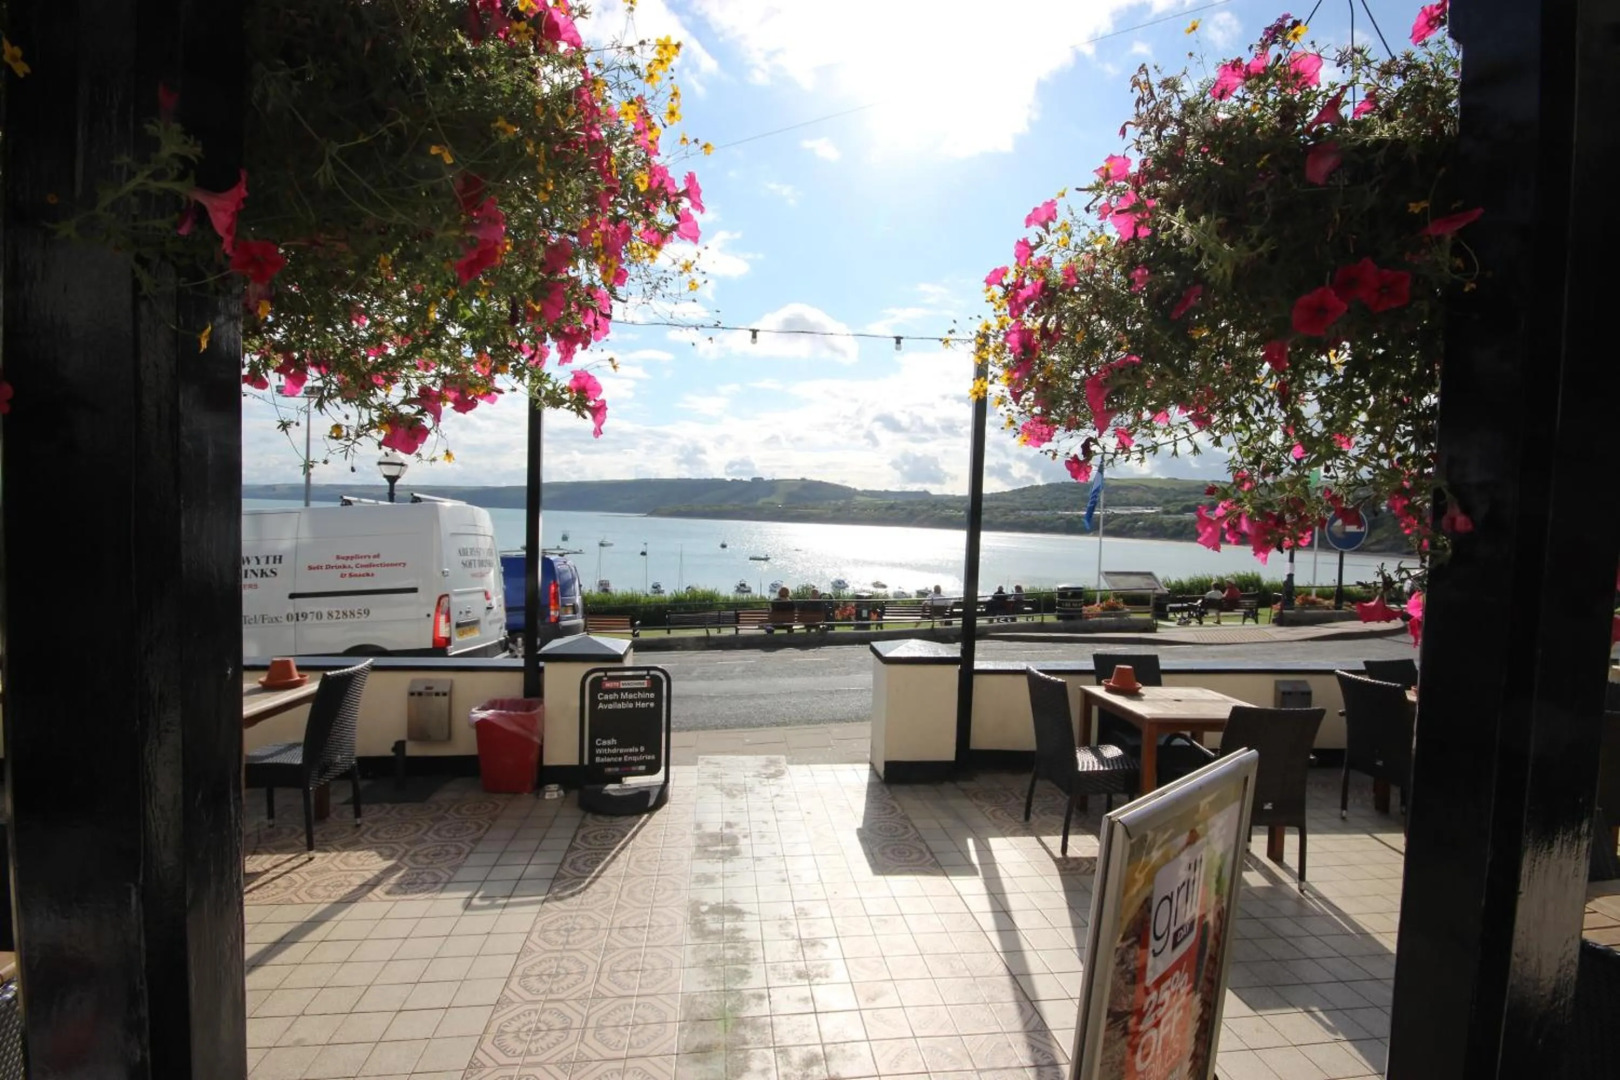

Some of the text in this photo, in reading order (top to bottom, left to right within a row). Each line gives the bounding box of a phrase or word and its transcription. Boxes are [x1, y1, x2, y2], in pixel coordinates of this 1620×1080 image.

[242, 555, 283, 566] WYTH
[243, 568, 278, 579] INKS
[286, 610, 323, 622] 01970
[326, 608, 371, 621] 828859
[597, 691, 655, 700] Cash Machine
[598, 701, 655, 710] Available Here
[595, 738, 617, 746] Cash
[595, 746, 639, 754] Withdrawals
[623, 754, 656, 762] Enquiries
[1152, 853, 1203, 958] grill
[1139, 964, 1190, 1034] 25%
[1135, 998, 1184, 1072] OFF
